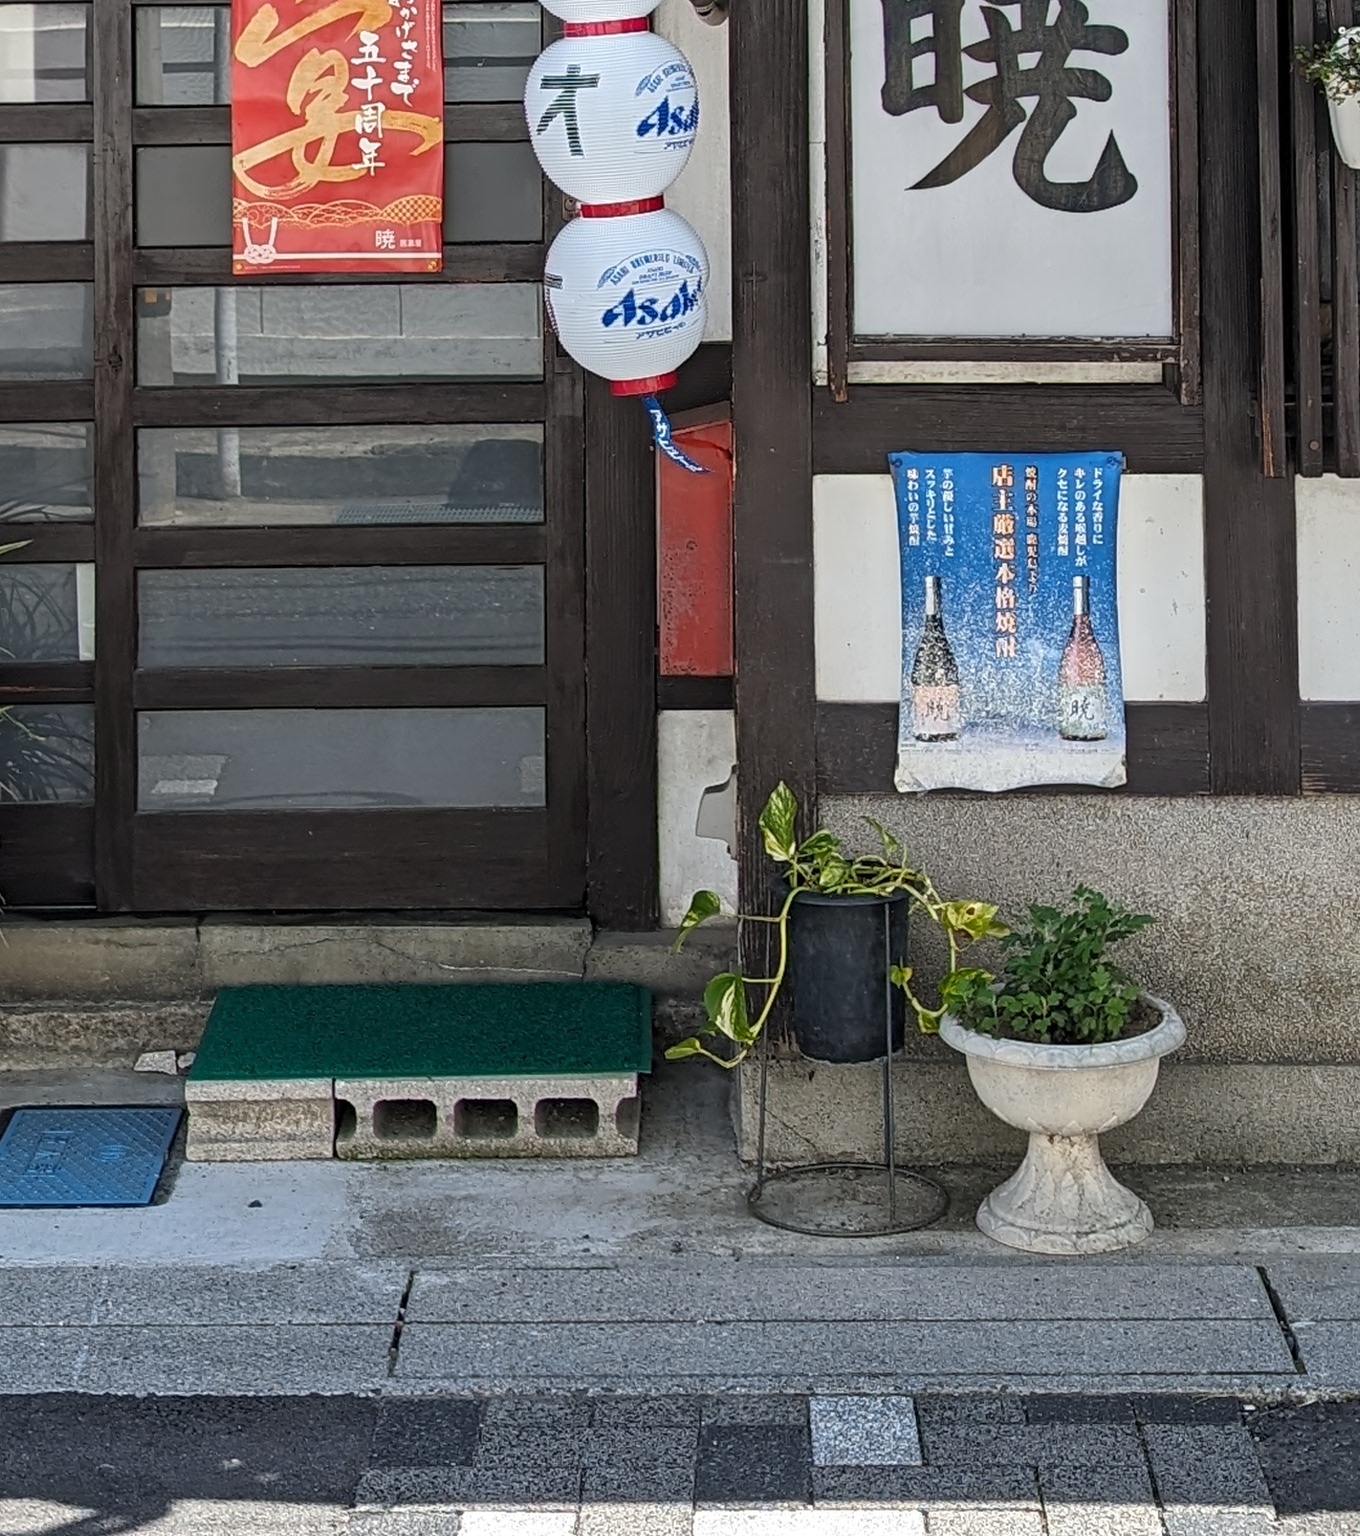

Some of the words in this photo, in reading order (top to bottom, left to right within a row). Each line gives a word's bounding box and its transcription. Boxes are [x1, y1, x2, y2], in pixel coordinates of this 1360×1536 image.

[351, 31, 387, 176] 五十周年
[537, 64, 601, 156] オ
[375, 228, 396, 249] 暁
[992, 464, 1018, 659] 店主厳選本格焼酎
